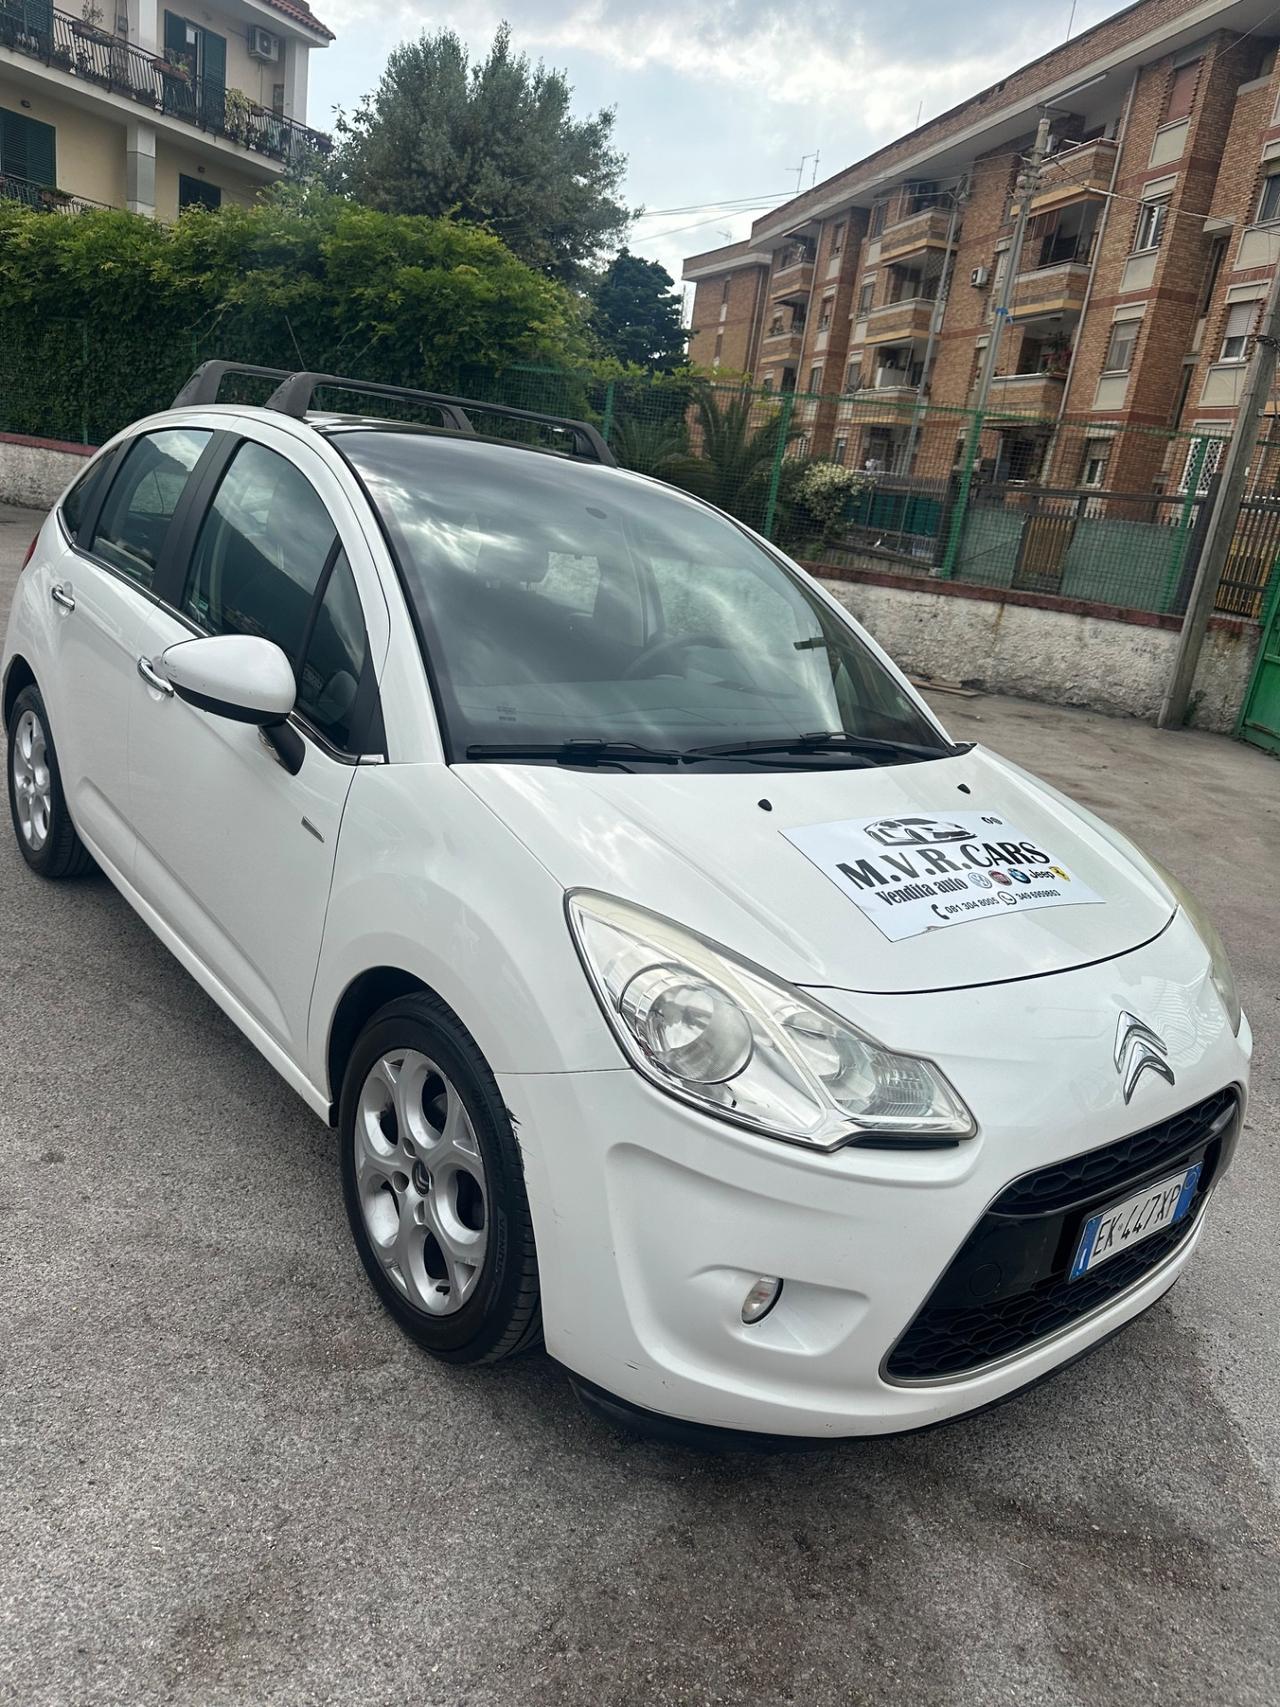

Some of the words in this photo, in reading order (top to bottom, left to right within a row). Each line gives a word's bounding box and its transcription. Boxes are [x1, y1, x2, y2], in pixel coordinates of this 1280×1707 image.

[1028, 869, 1056, 880] Jeep
[875, 881, 937, 906] Vendita
[937, 876, 969, 897] auto
[1015, 891, 1032, 900] 349
[944, 904, 962, 914] 081
[961, 901, 979, 911] 304
[1121, 1184, 1182, 1240] 447XP
